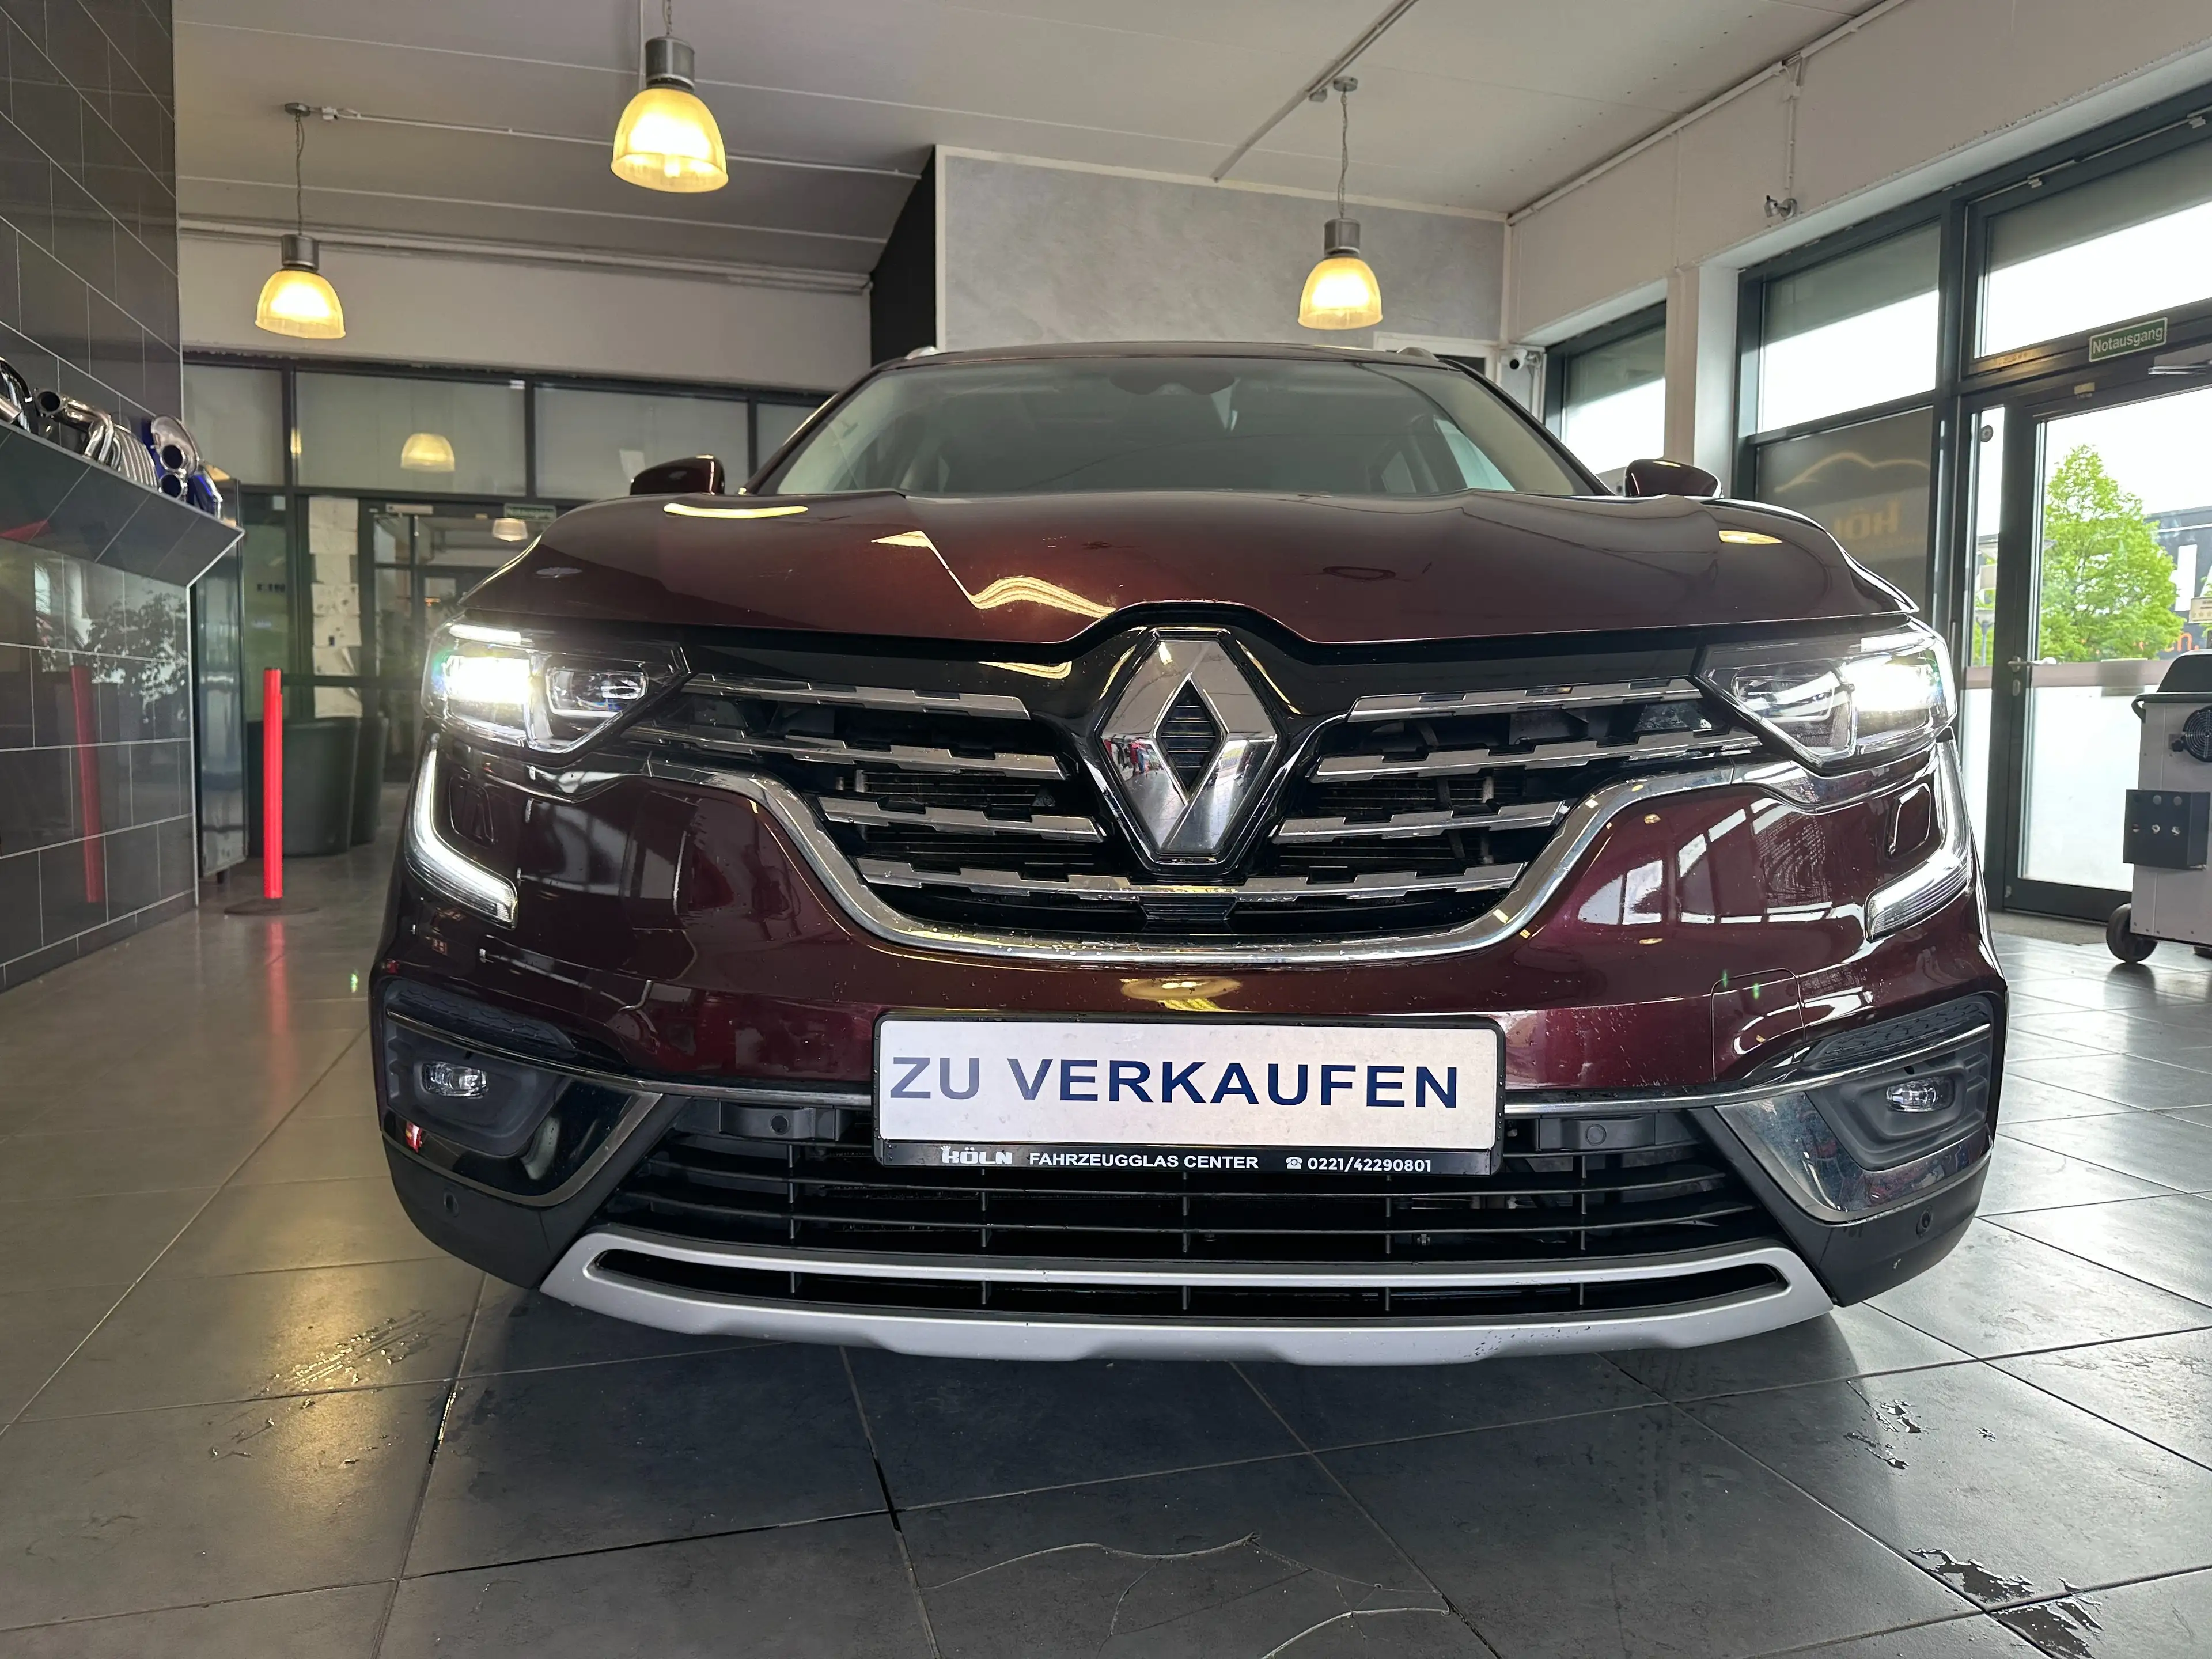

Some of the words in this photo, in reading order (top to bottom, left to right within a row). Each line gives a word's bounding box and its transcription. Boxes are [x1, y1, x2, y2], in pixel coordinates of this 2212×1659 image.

[2092, 327, 2164, 354] Notausgang
[890, 1056, 980, 1100] ZU
[1007, 1058, 1457, 1108] VERKAUFEN
[940, 1145, 1013, 1165] KÖLN
[1029, 1153, 1179, 1168] FAHRZEUGGLAS
[1184, 1156, 1259, 1169] CENTER
[1308, 1157, 1431, 1172] 0221/42290801
